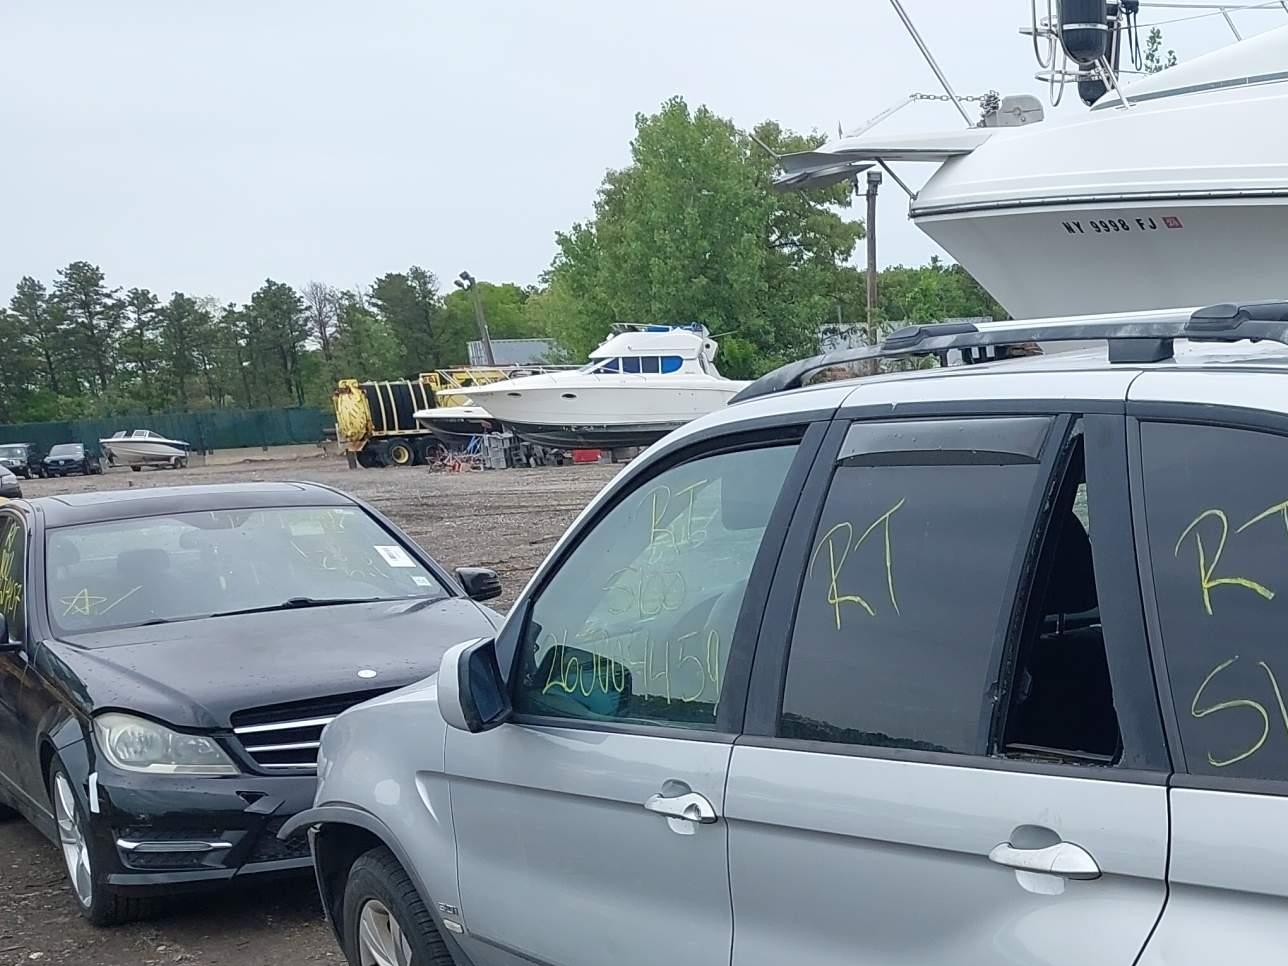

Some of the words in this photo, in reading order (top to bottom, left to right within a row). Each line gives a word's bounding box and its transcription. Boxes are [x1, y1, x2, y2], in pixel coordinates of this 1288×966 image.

[1062, 221, 1086, 234] NY
[1090, 218, 1130, 233] 9998
[1136, 217, 1158, 231] FJ
[810, 497, 906, 631] RT
